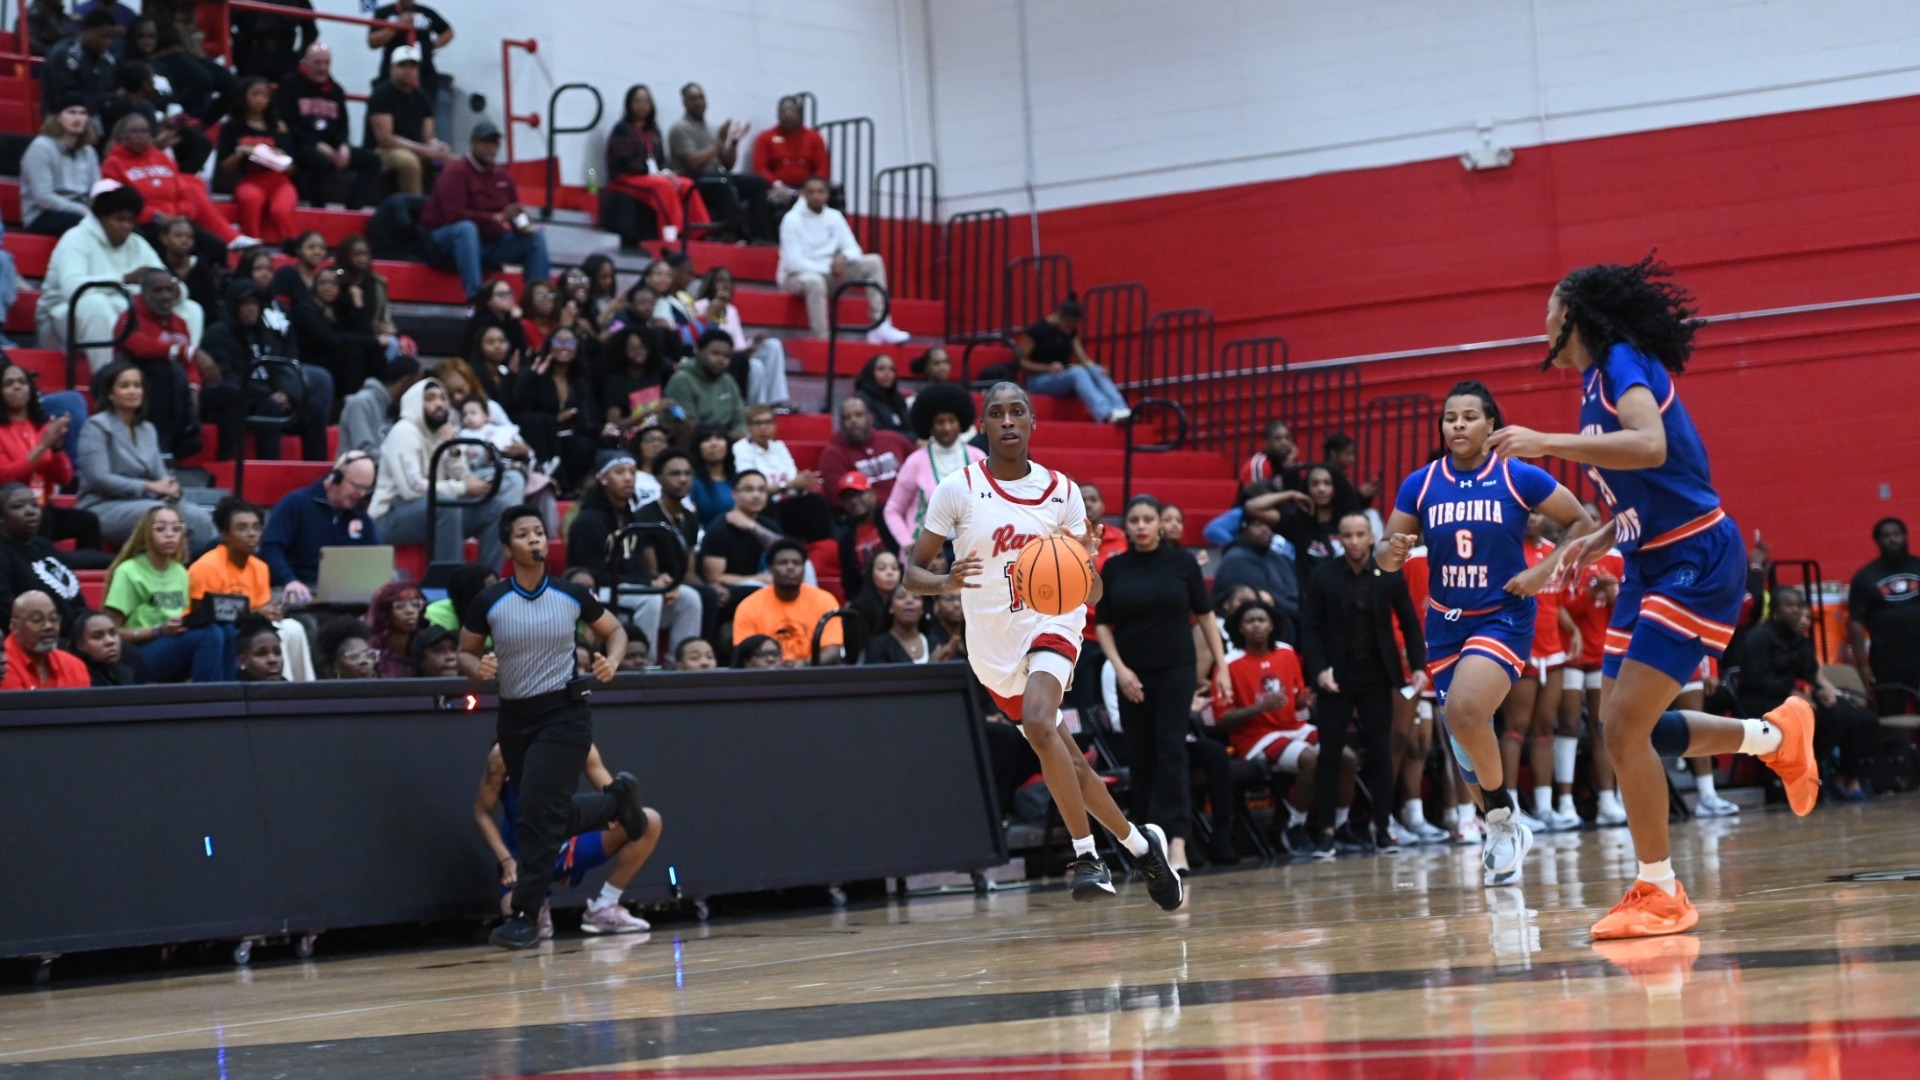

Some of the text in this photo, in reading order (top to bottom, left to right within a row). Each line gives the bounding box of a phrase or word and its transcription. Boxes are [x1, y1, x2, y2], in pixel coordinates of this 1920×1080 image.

[1428, 500, 1504, 529] VIRGINIA
[1455, 529, 1474, 559] 6
[1441, 565, 1488, 588] STATE
